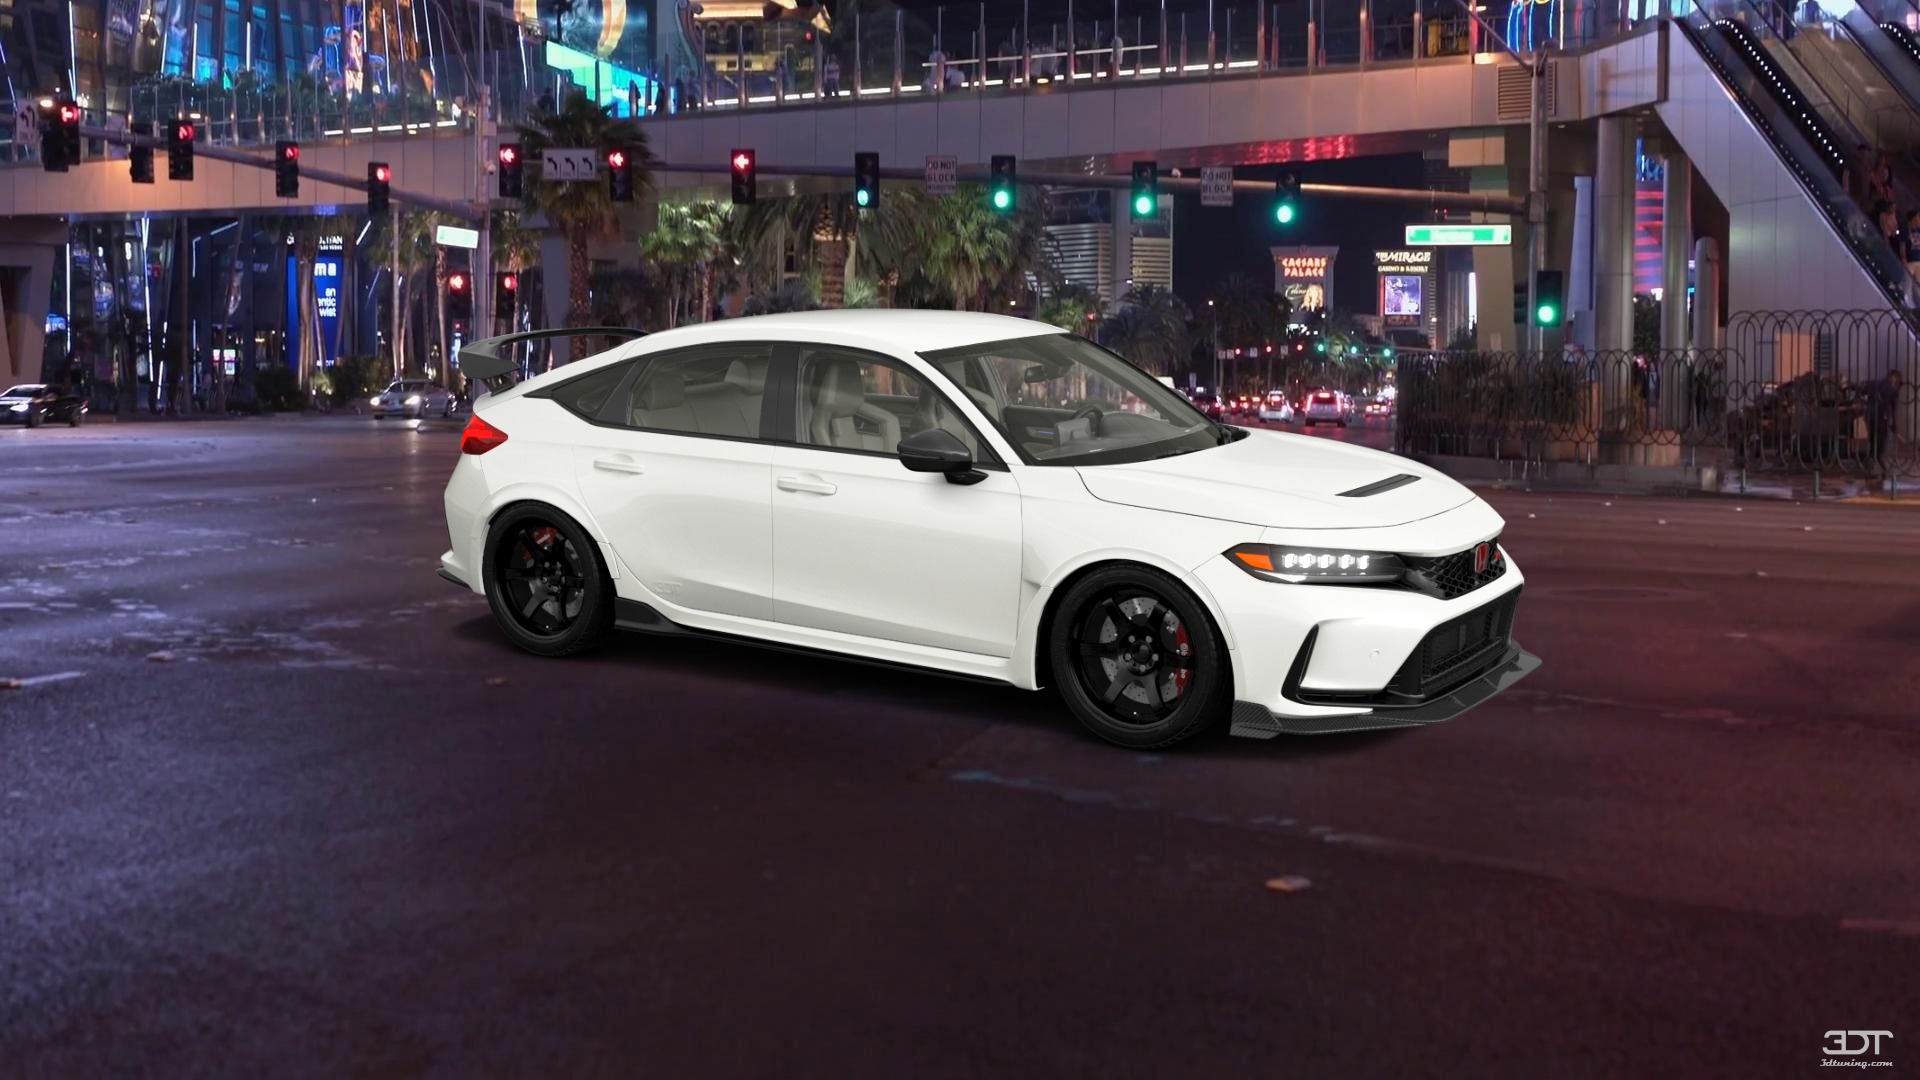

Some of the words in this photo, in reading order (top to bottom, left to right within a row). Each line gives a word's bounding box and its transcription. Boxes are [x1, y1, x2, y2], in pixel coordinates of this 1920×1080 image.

[1202, 183, 1230, 193] BLOCK
[1281, 257, 1327, 267] CAESARS
[1380, 251, 1431, 263] MIRAGE
[1283, 267, 1324, 277] PALACE
